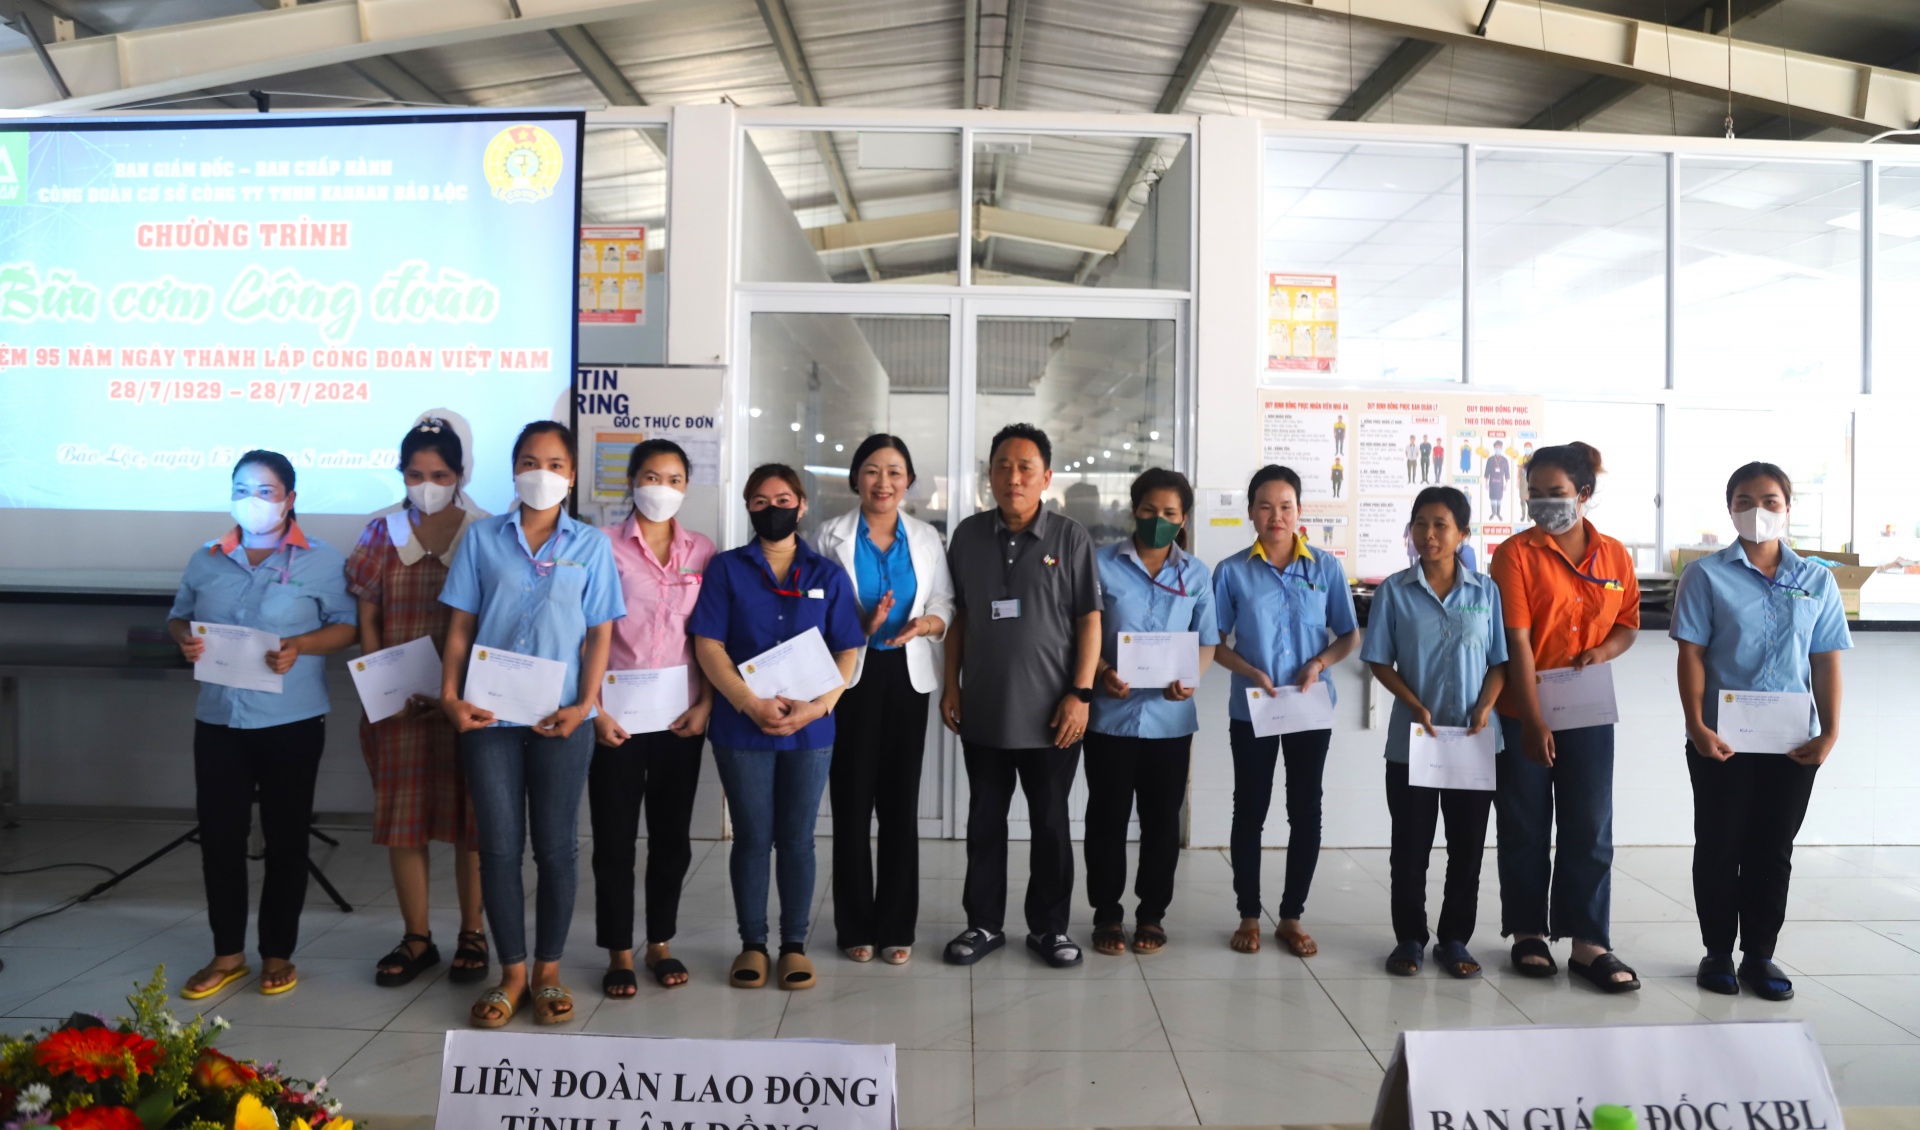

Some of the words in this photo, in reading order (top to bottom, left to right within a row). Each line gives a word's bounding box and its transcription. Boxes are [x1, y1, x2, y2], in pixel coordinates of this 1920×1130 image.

[115, 161, 149, 178] BAN
[153, 157, 196, 178] GIÁM
[200, 156, 235, 177] ĐỐC
[255, 161, 290, 177] BAN
[294, 155, 342, 177] CHẤP
[345, 156, 393, 177] HÀNH
[39, 185, 83, 203] CÔNG
[87, 183, 133, 203] ĐOÀN
[191, 184, 236, 202] CÔNG
[240, 186, 264, 202] TY
[268, 186, 316, 202] TNHH
[321, 185, 389, 201] KANAAN
[393, 179, 430, 201] BẢO
[433, 181, 469, 204] LỘC
[137, 217, 248, 247] CHƯƠNG
[259, 216, 348, 247] TRÌNH
[0, 265, 97, 319] Bữa
[113, 279, 210, 319] cơm
[227, 268, 357, 341] Công
[374, 264, 495, 319] đoàn
[36, 348, 60, 366] 95
[68, 345, 112, 366] NĂM
[121, 345, 175, 367] NGÀY
[183, 345, 256, 367] THÀNH
[264, 344, 305, 372] LẬP
[312, 343, 368, 368] CÔNG
[376, 344, 433, 368] ĐOÀN
[442, 345, 492, 373] VIỆT
[500, 350, 550, 369] NAM
[577, 369, 618, 391] TIN
[110, 381, 221, 403] 28/7/1929
[249, 382, 368, 404] 28/7/2024
[1464, 417, 1479, 425] THEO
[1497, 416, 1513, 426] CÔNG
[1466, 405, 1478, 413] QUY
[1479, 405, 1493, 414] ĐỊNH
[1495, 404, 1511, 413] ĐỒNG
[1512, 406, 1528, 415] PHỤC
[613, 415, 640, 429] GÓC
[644, 414, 680, 431] THỰC
[686, 414, 714, 429] ĐƠN
[320, 451, 363, 466] năm
[450, 1058, 541, 1097] LIÊN
[551, 1062, 662, 1102] ĐOÀN
[671, 1073, 754, 1104] LAO
[763, 1071, 879, 1115] ĐỘNG
[1523, 1096, 1634, 1130] GIÁ
[1643, 1093, 1733, 1130] ĐỐC
[1739, 1099, 1827, 1130] KBL
